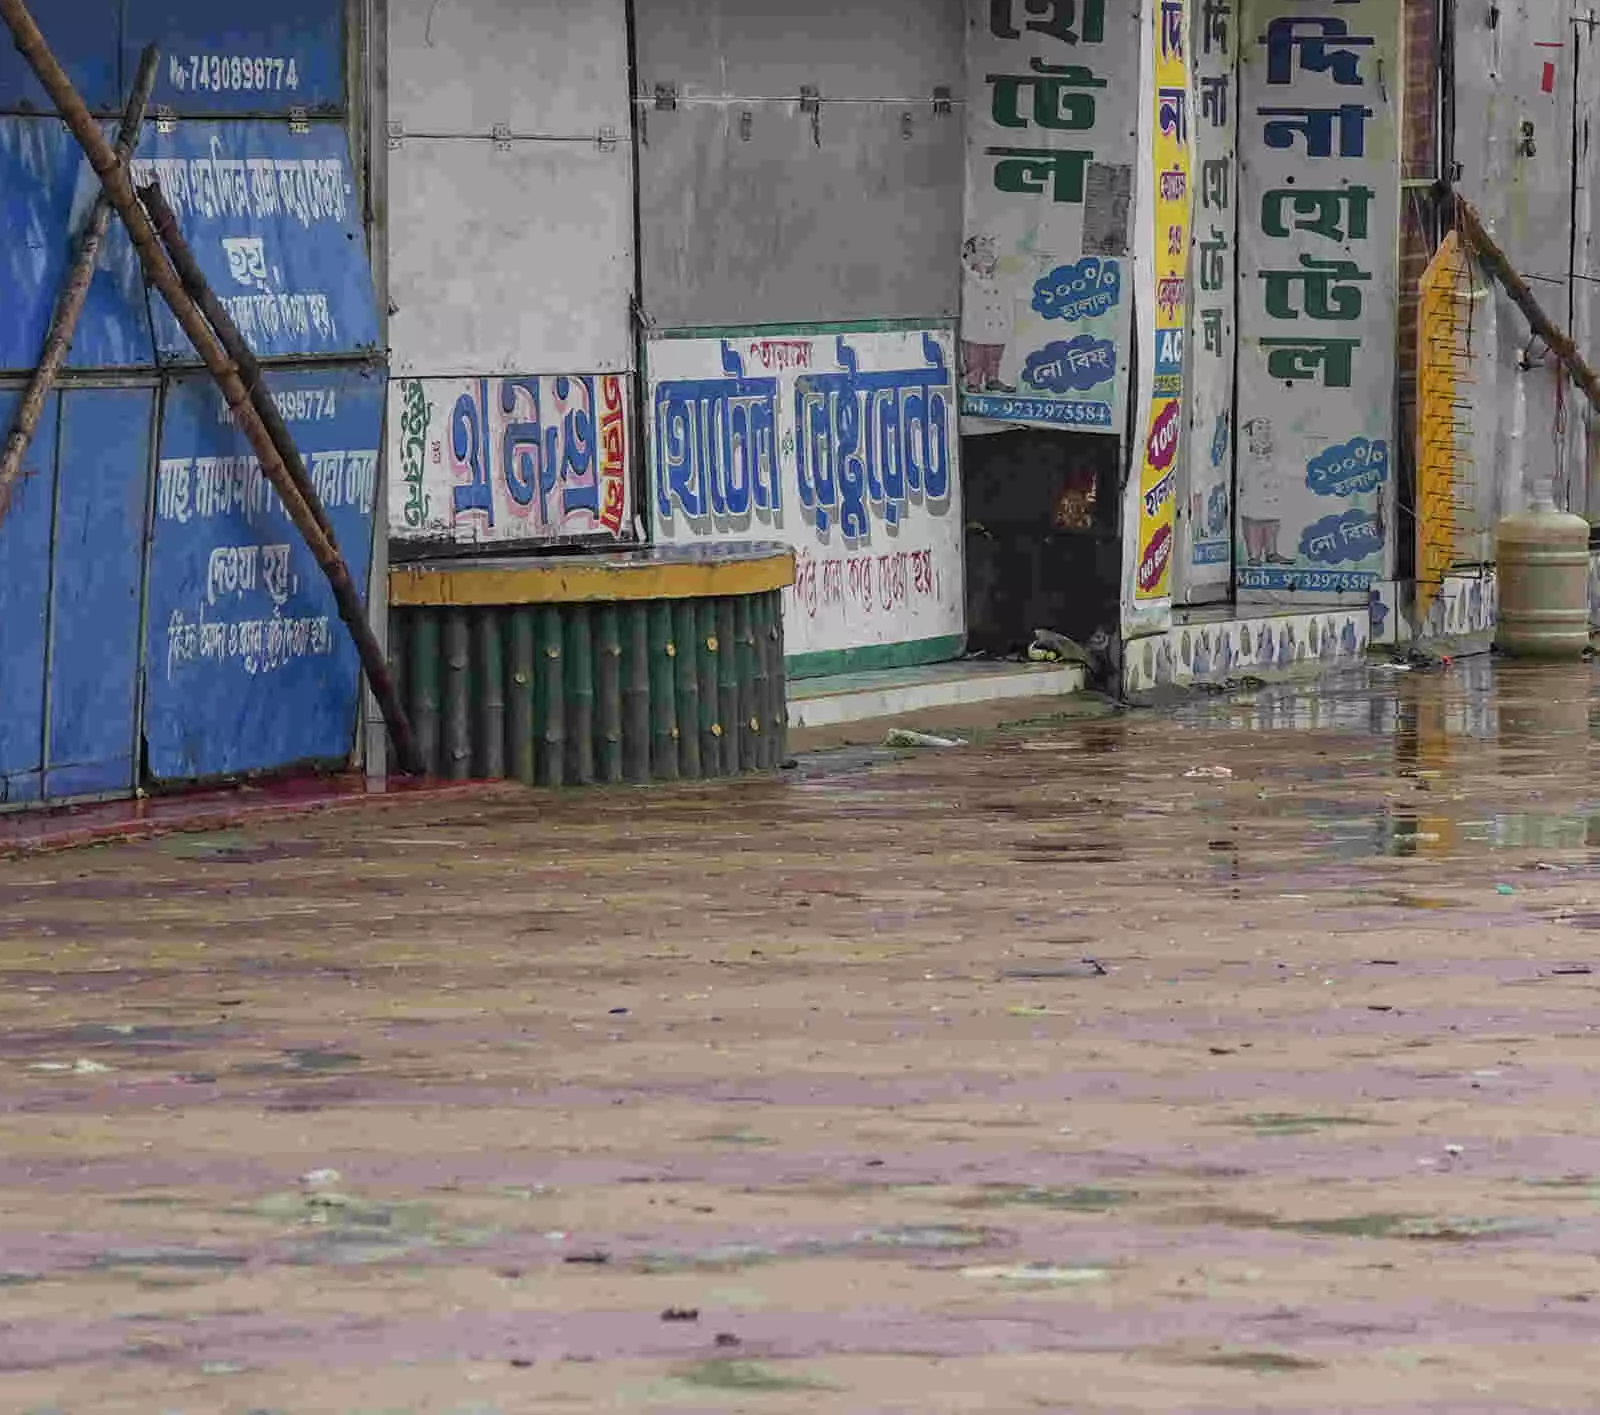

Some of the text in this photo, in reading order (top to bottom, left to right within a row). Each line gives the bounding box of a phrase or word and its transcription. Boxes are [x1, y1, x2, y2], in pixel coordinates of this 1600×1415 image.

[1257, 184, 1376, 388] হোটেল
[1061, 291, 1114, 320] হালাল
[1159, 331, 1184, 364] AC
[1032, 363, 1064, 386] নো
[655, 332, 950, 540] হোটেল রেষ্টুরেন্ট
[1309, 535, 1336, 555] নো
